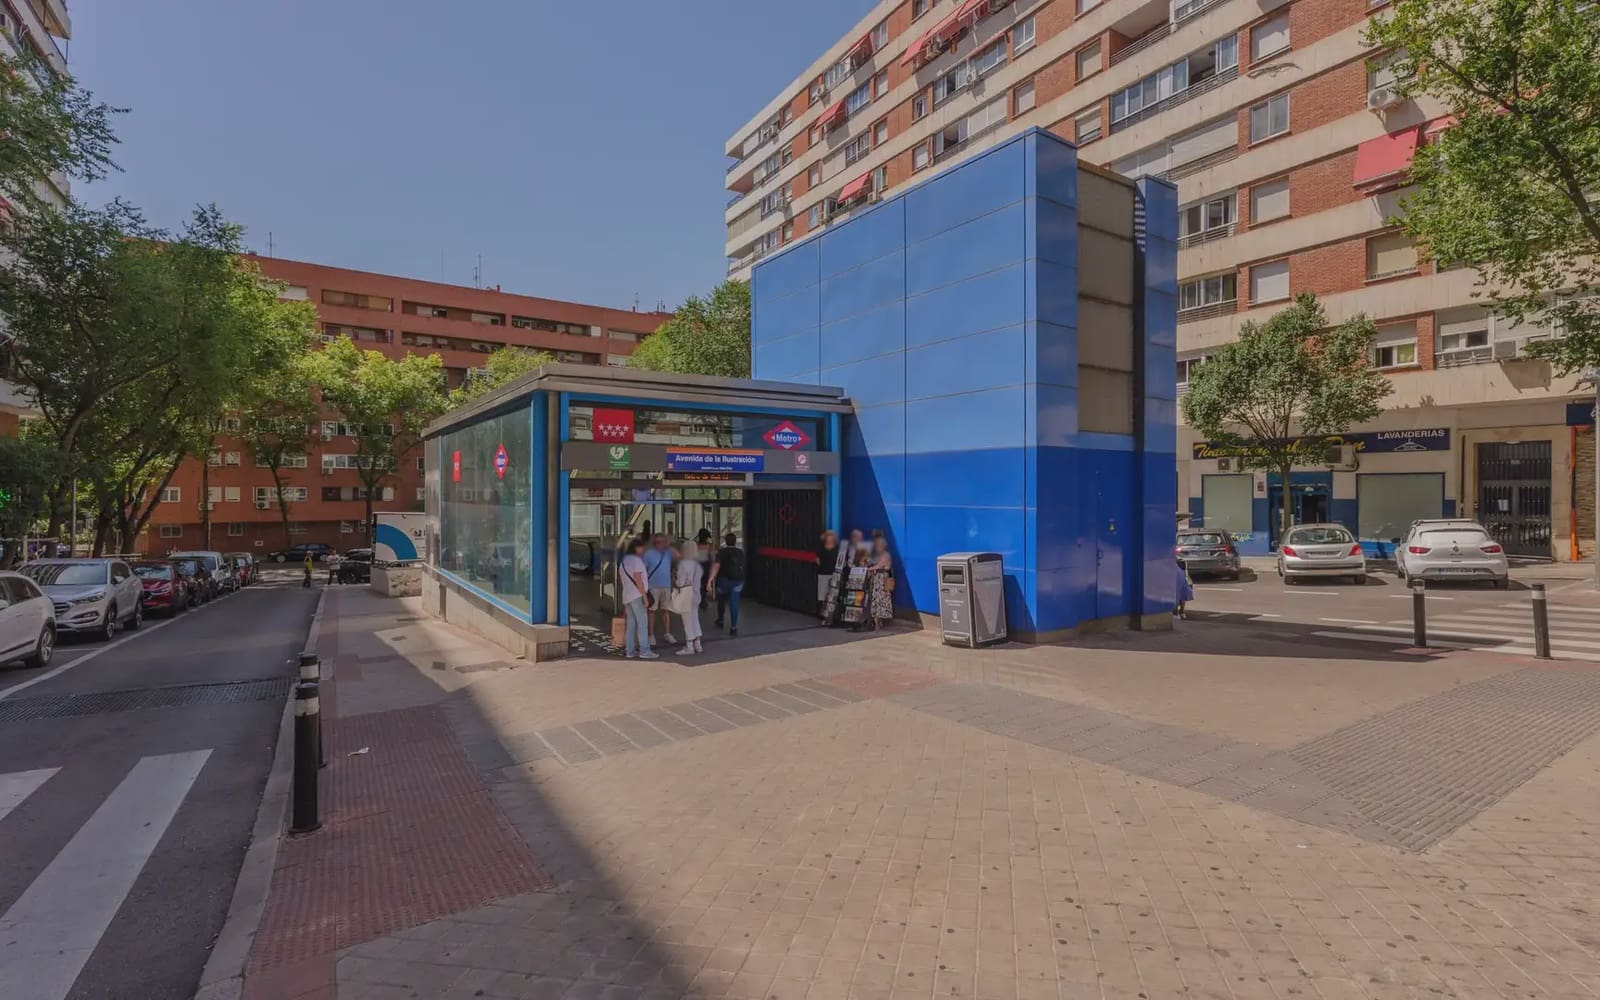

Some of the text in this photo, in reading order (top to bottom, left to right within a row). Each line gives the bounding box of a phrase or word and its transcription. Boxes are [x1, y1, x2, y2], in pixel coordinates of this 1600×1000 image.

[775, 433, 798, 443] Metro
[1377, 429, 1445, 440] LAVANDERIAS
[675, 455, 703, 463] Avenida
[714, 455, 722, 463] la
[722, 456, 756, 464] Ilustración
